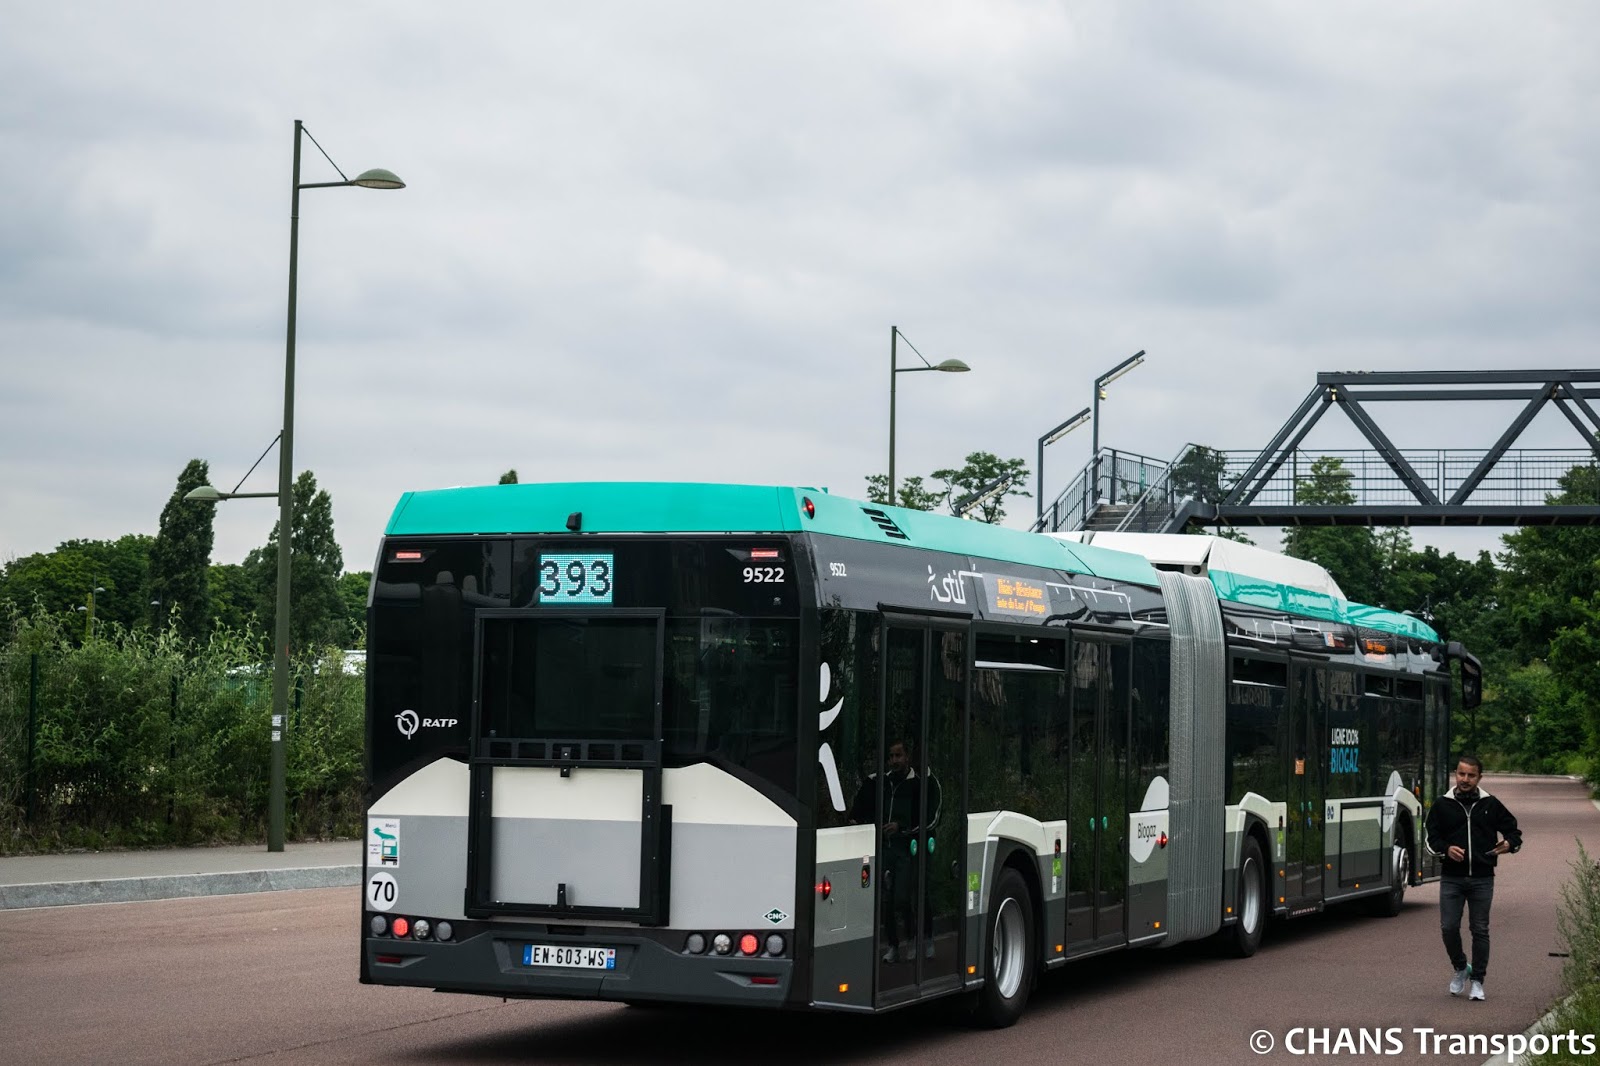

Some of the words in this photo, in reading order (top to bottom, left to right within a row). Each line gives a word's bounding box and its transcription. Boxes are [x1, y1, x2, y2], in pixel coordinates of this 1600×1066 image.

[540, 561, 610, 596] 393
[743, 567, 785, 583] 9522
[829, 562, 847, 577] 9522
[422, 718, 458, 728] RATP
[1331, 727, 1346, 745] LIGNE
[1330, 747, 1359, 774] BIOGAZ
[1137, 822, 1157, 843] Biogaz
[372, 881, 395, 902] 70
[607, 959, 615, 967] 75
